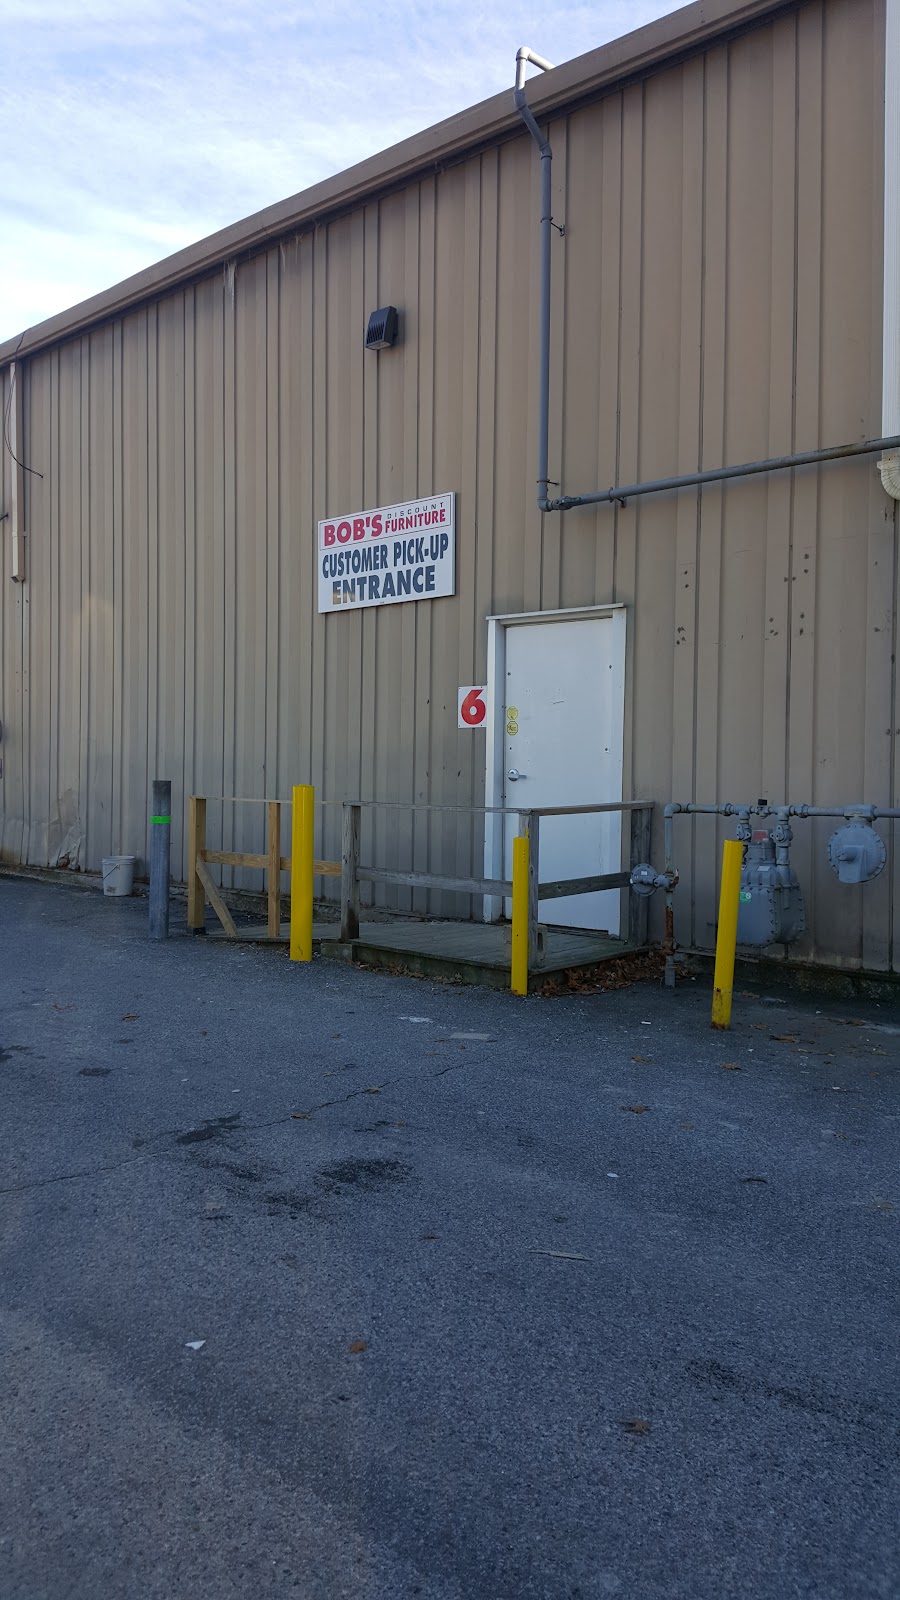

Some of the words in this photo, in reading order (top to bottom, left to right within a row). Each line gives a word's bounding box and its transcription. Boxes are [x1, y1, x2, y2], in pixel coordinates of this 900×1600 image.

[324, 514, 382, 546] BOB'S
[385, 509, 446, 533] FURNITURE
[387, 502, 444, 519] DISCOUNT
[322, 544, 389, 578] CUSTOMER
[394, 533, 449, 567] PICK-UP
[332, 565, 436, 605] ENTRANCE
[461, 689, 486, 725] 6
